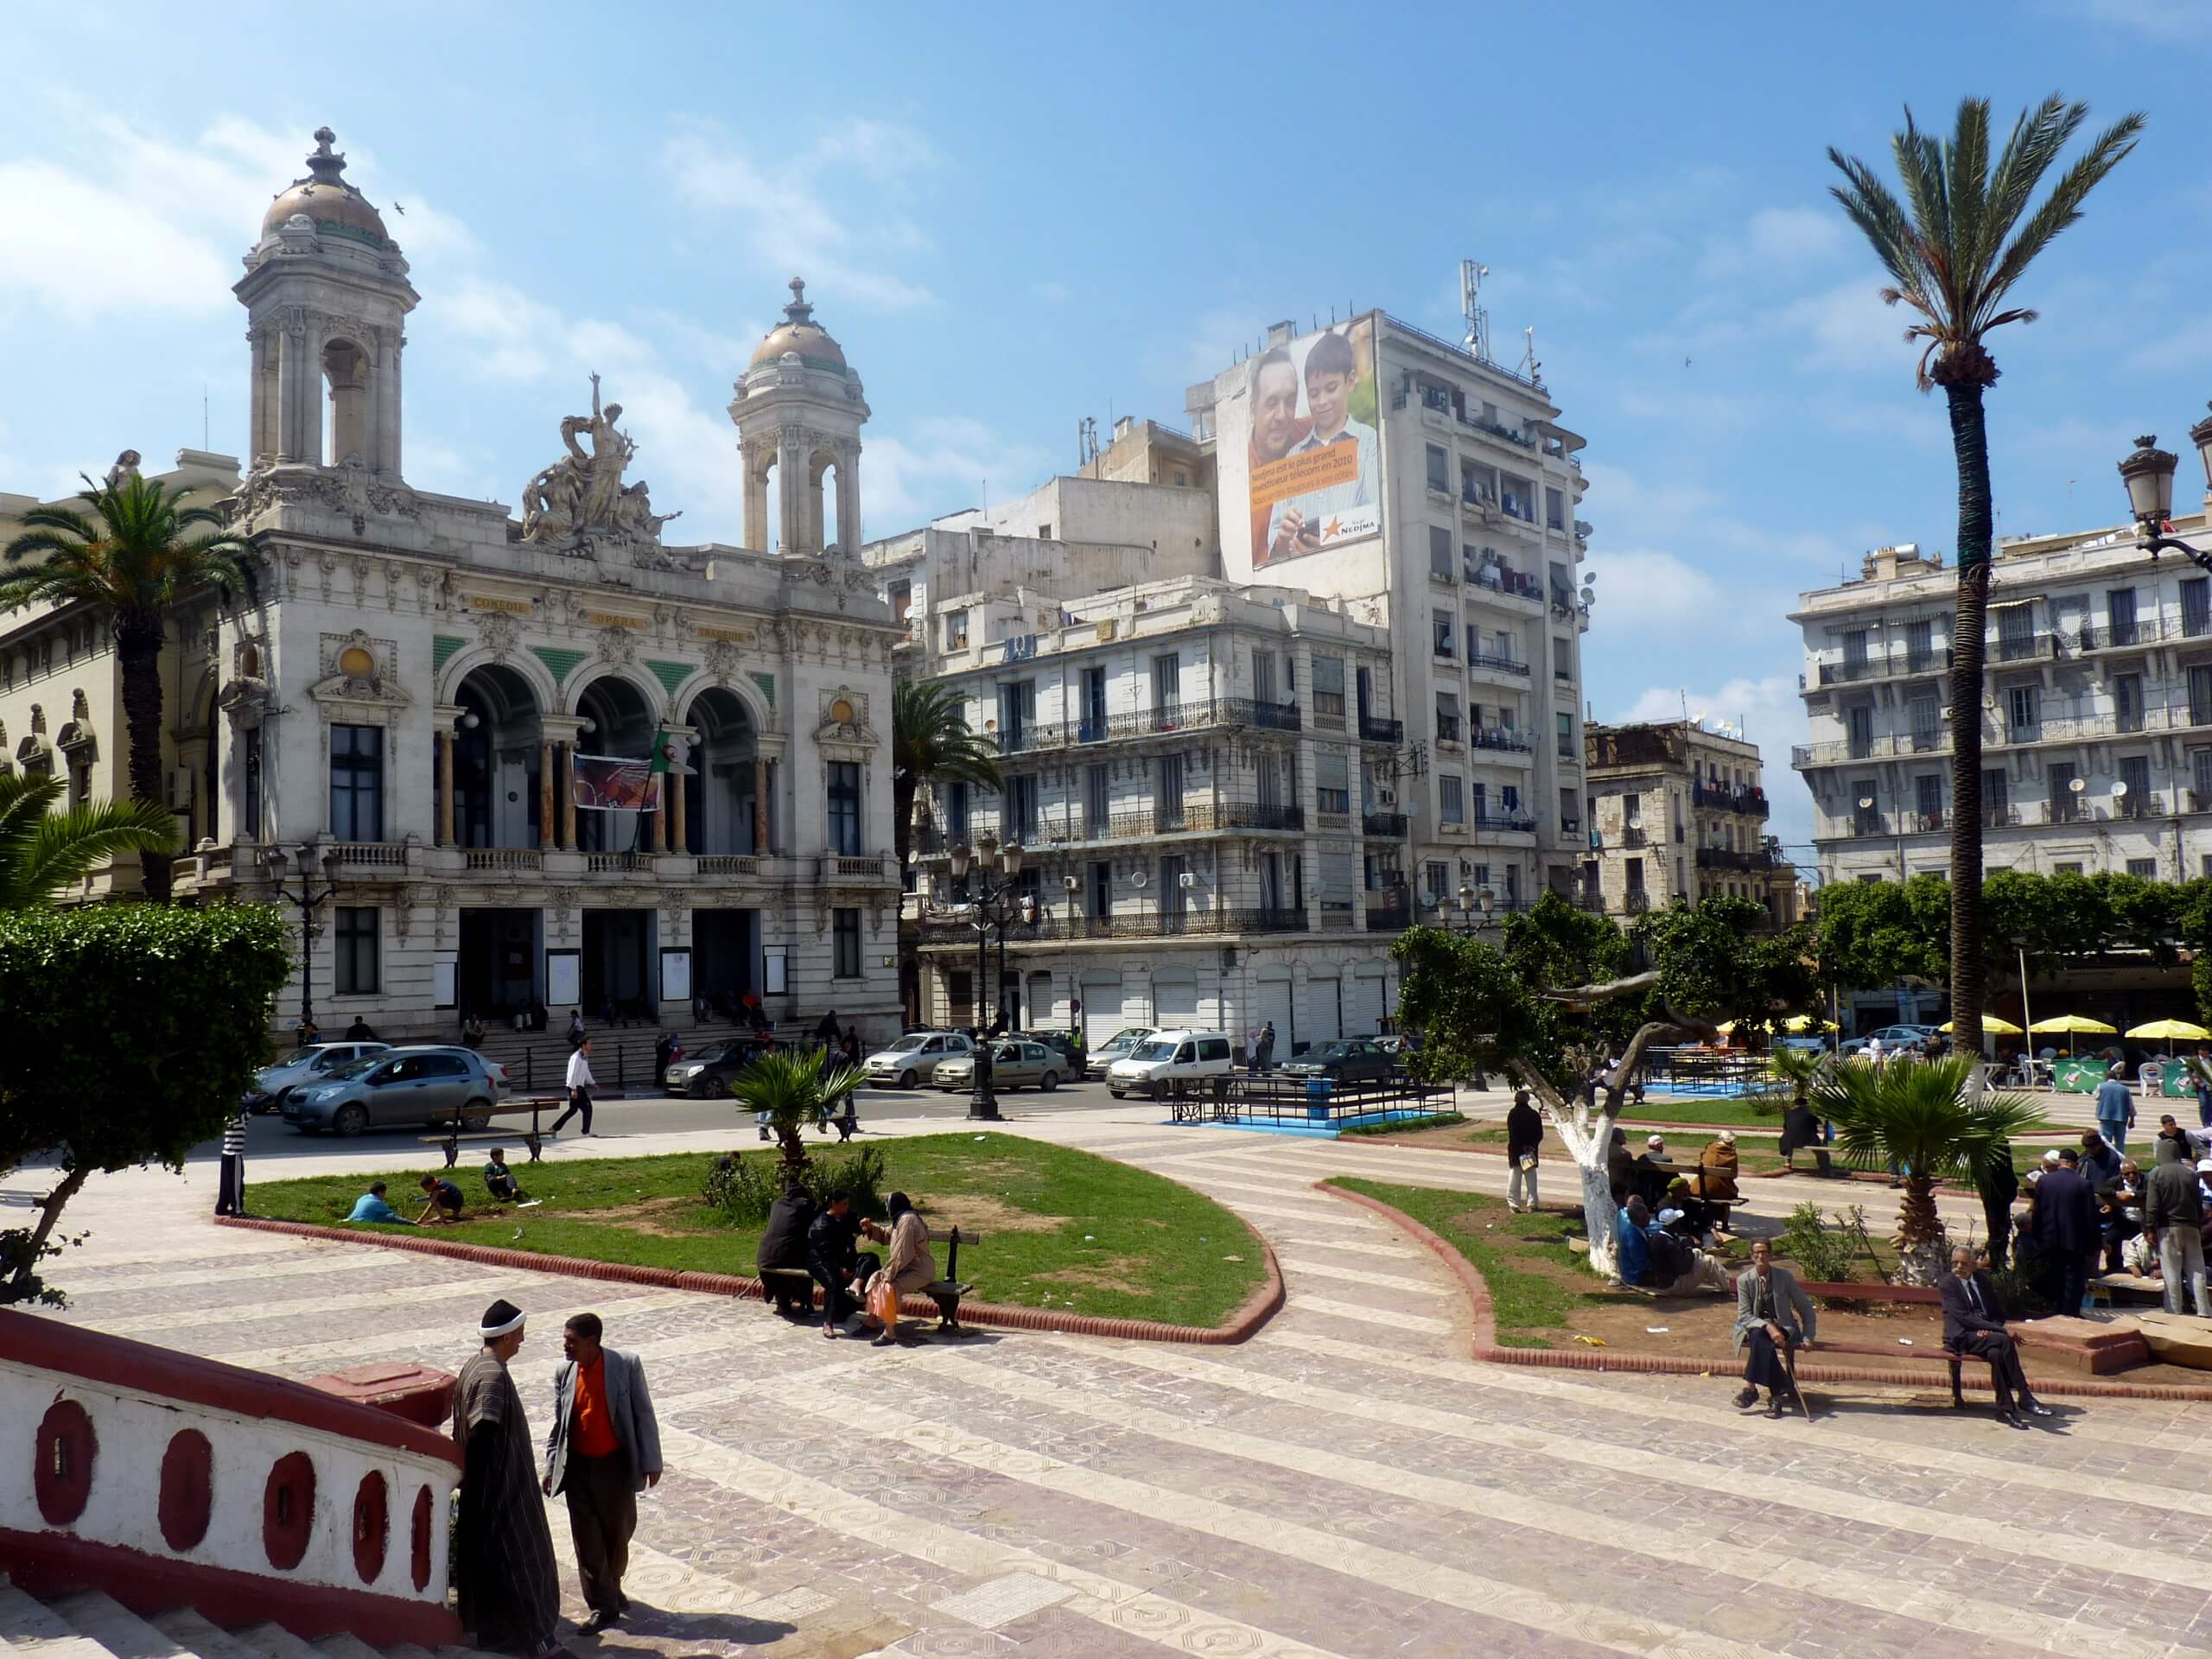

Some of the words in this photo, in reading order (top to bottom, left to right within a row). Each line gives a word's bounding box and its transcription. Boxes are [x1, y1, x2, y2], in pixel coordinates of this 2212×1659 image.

[1276, 462, 1287, 473] est
[1297, 456, 1312, 467] plus
[1313, 448, 1335, 464] grand
[1322, 462, 1332, 471] en
[1333, 454, 1353, 468] 2010
